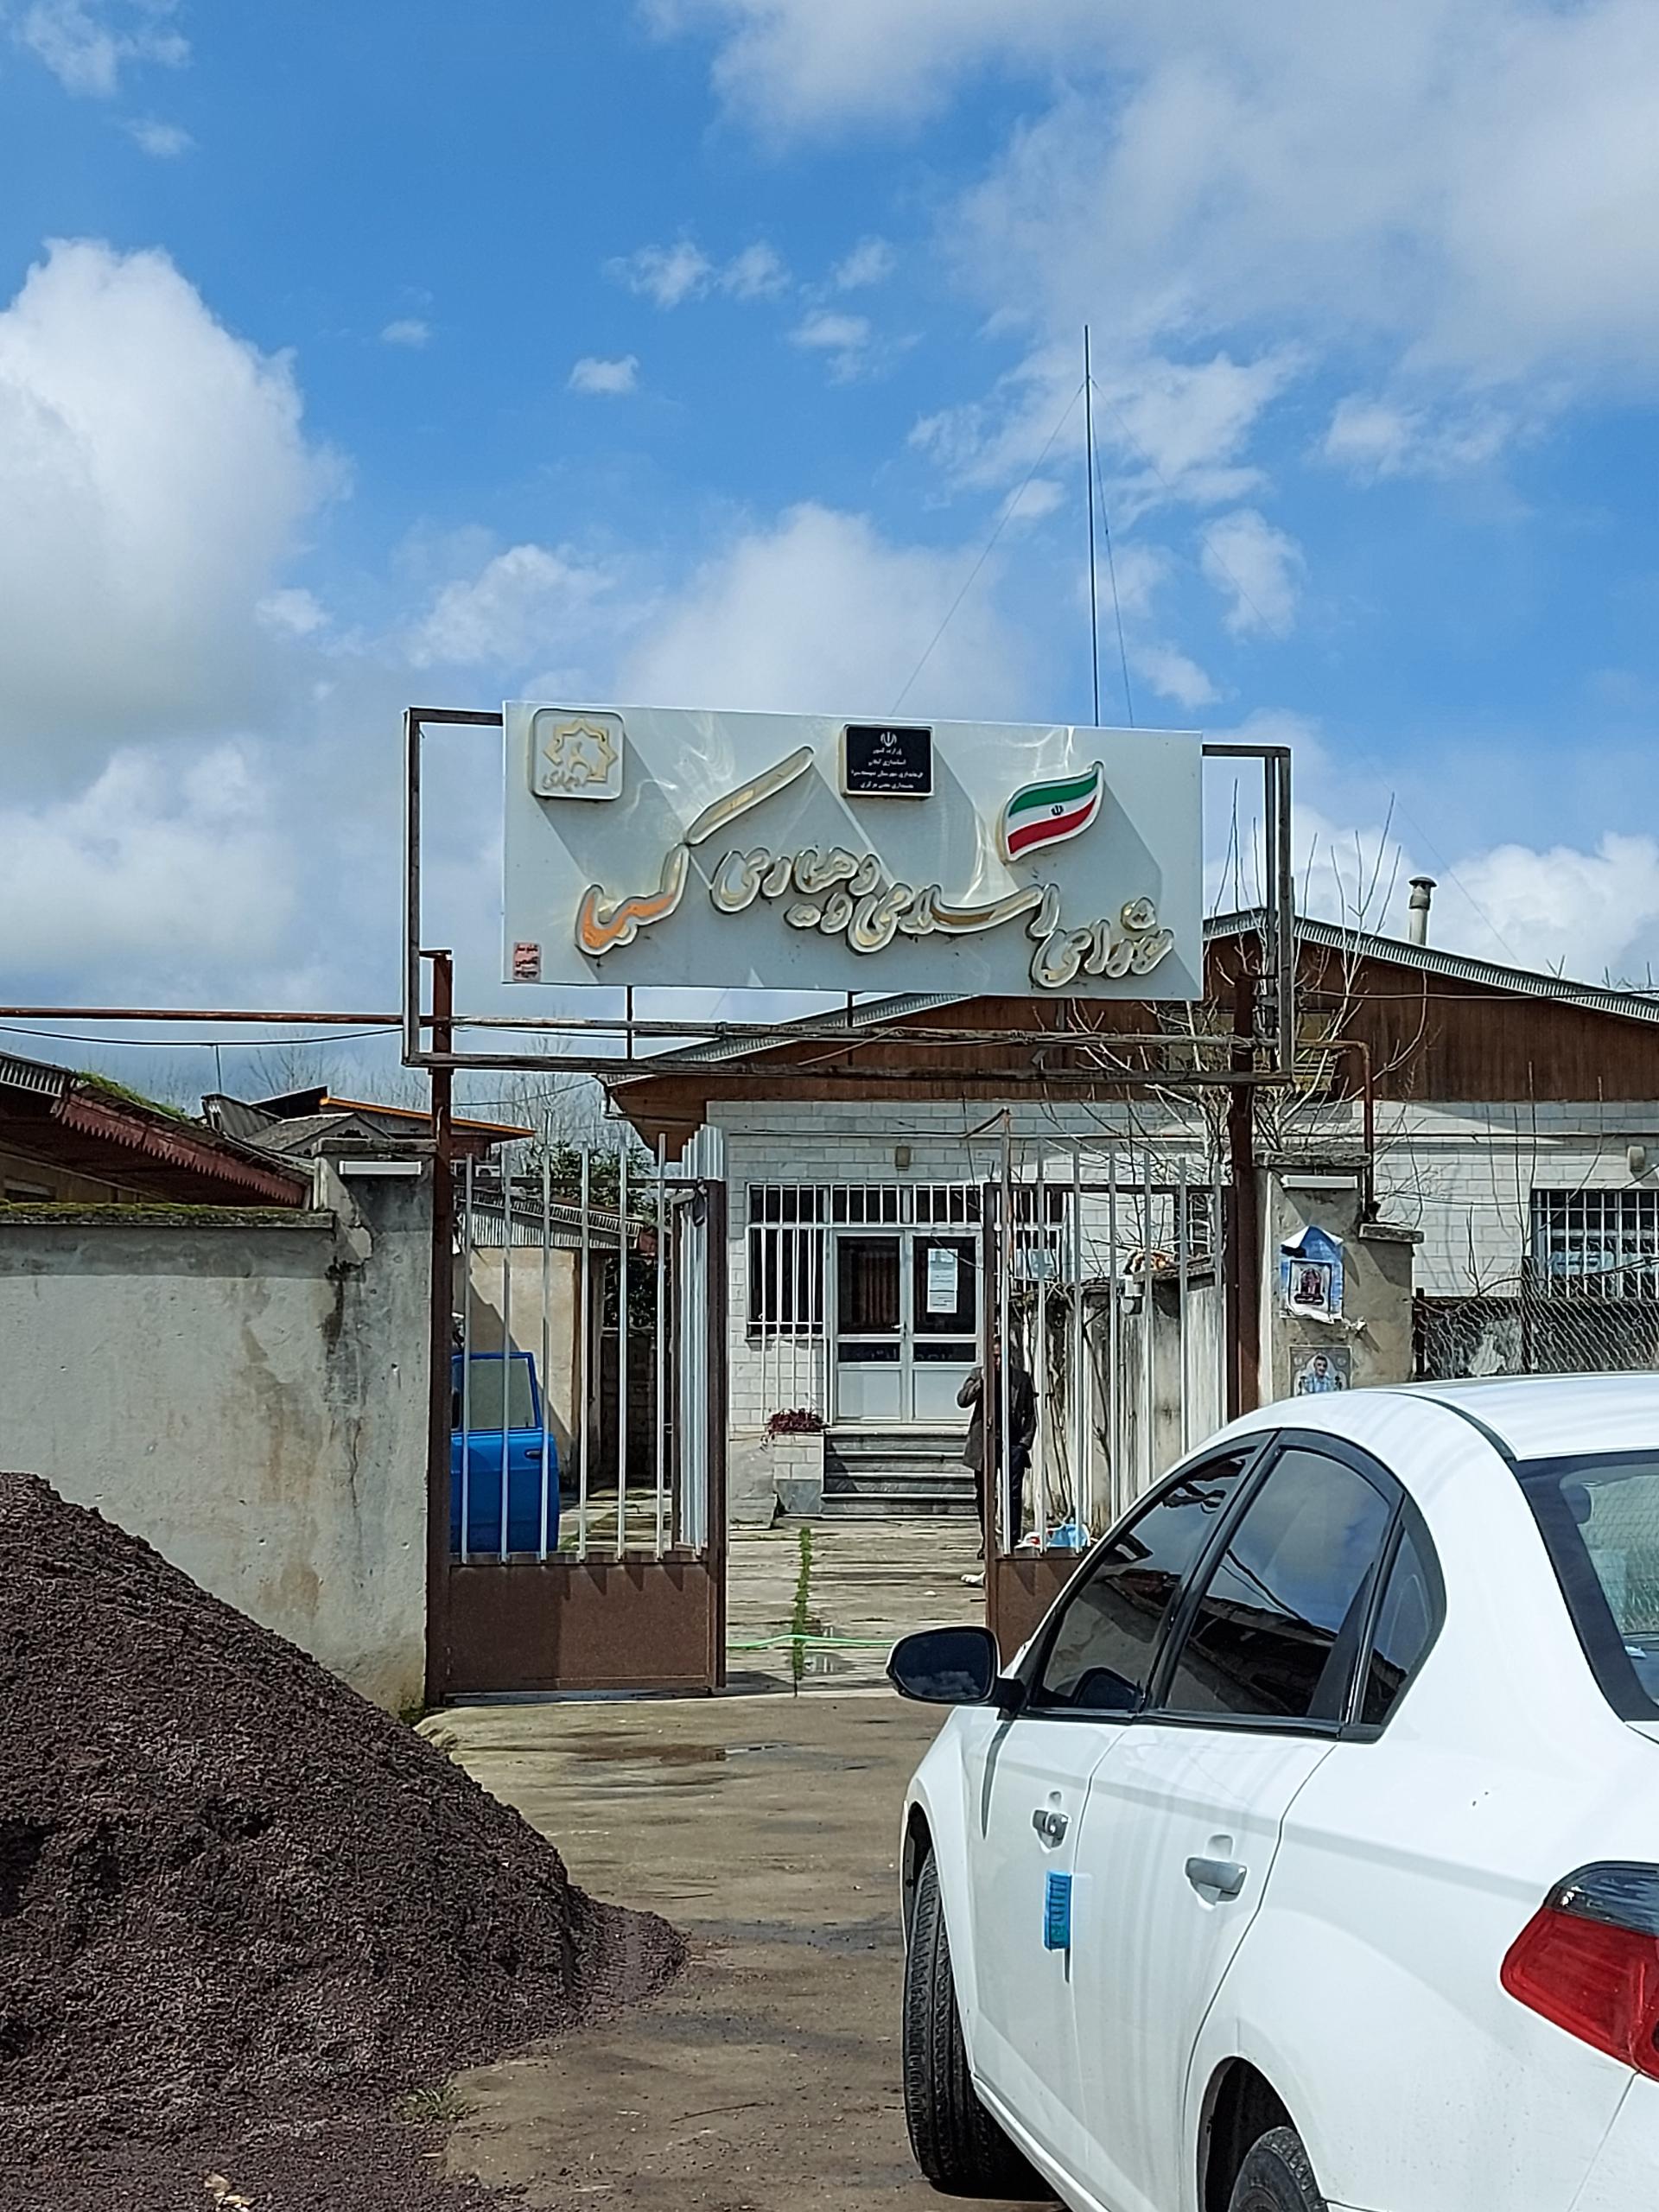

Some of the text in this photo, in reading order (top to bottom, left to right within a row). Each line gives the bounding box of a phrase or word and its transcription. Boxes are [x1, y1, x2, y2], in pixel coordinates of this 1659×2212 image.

[709, 845, 882, 929] دهیاری
[847, 882, 1060, 956] اسلامی
[1031, 895, 1174, 988] شورای
